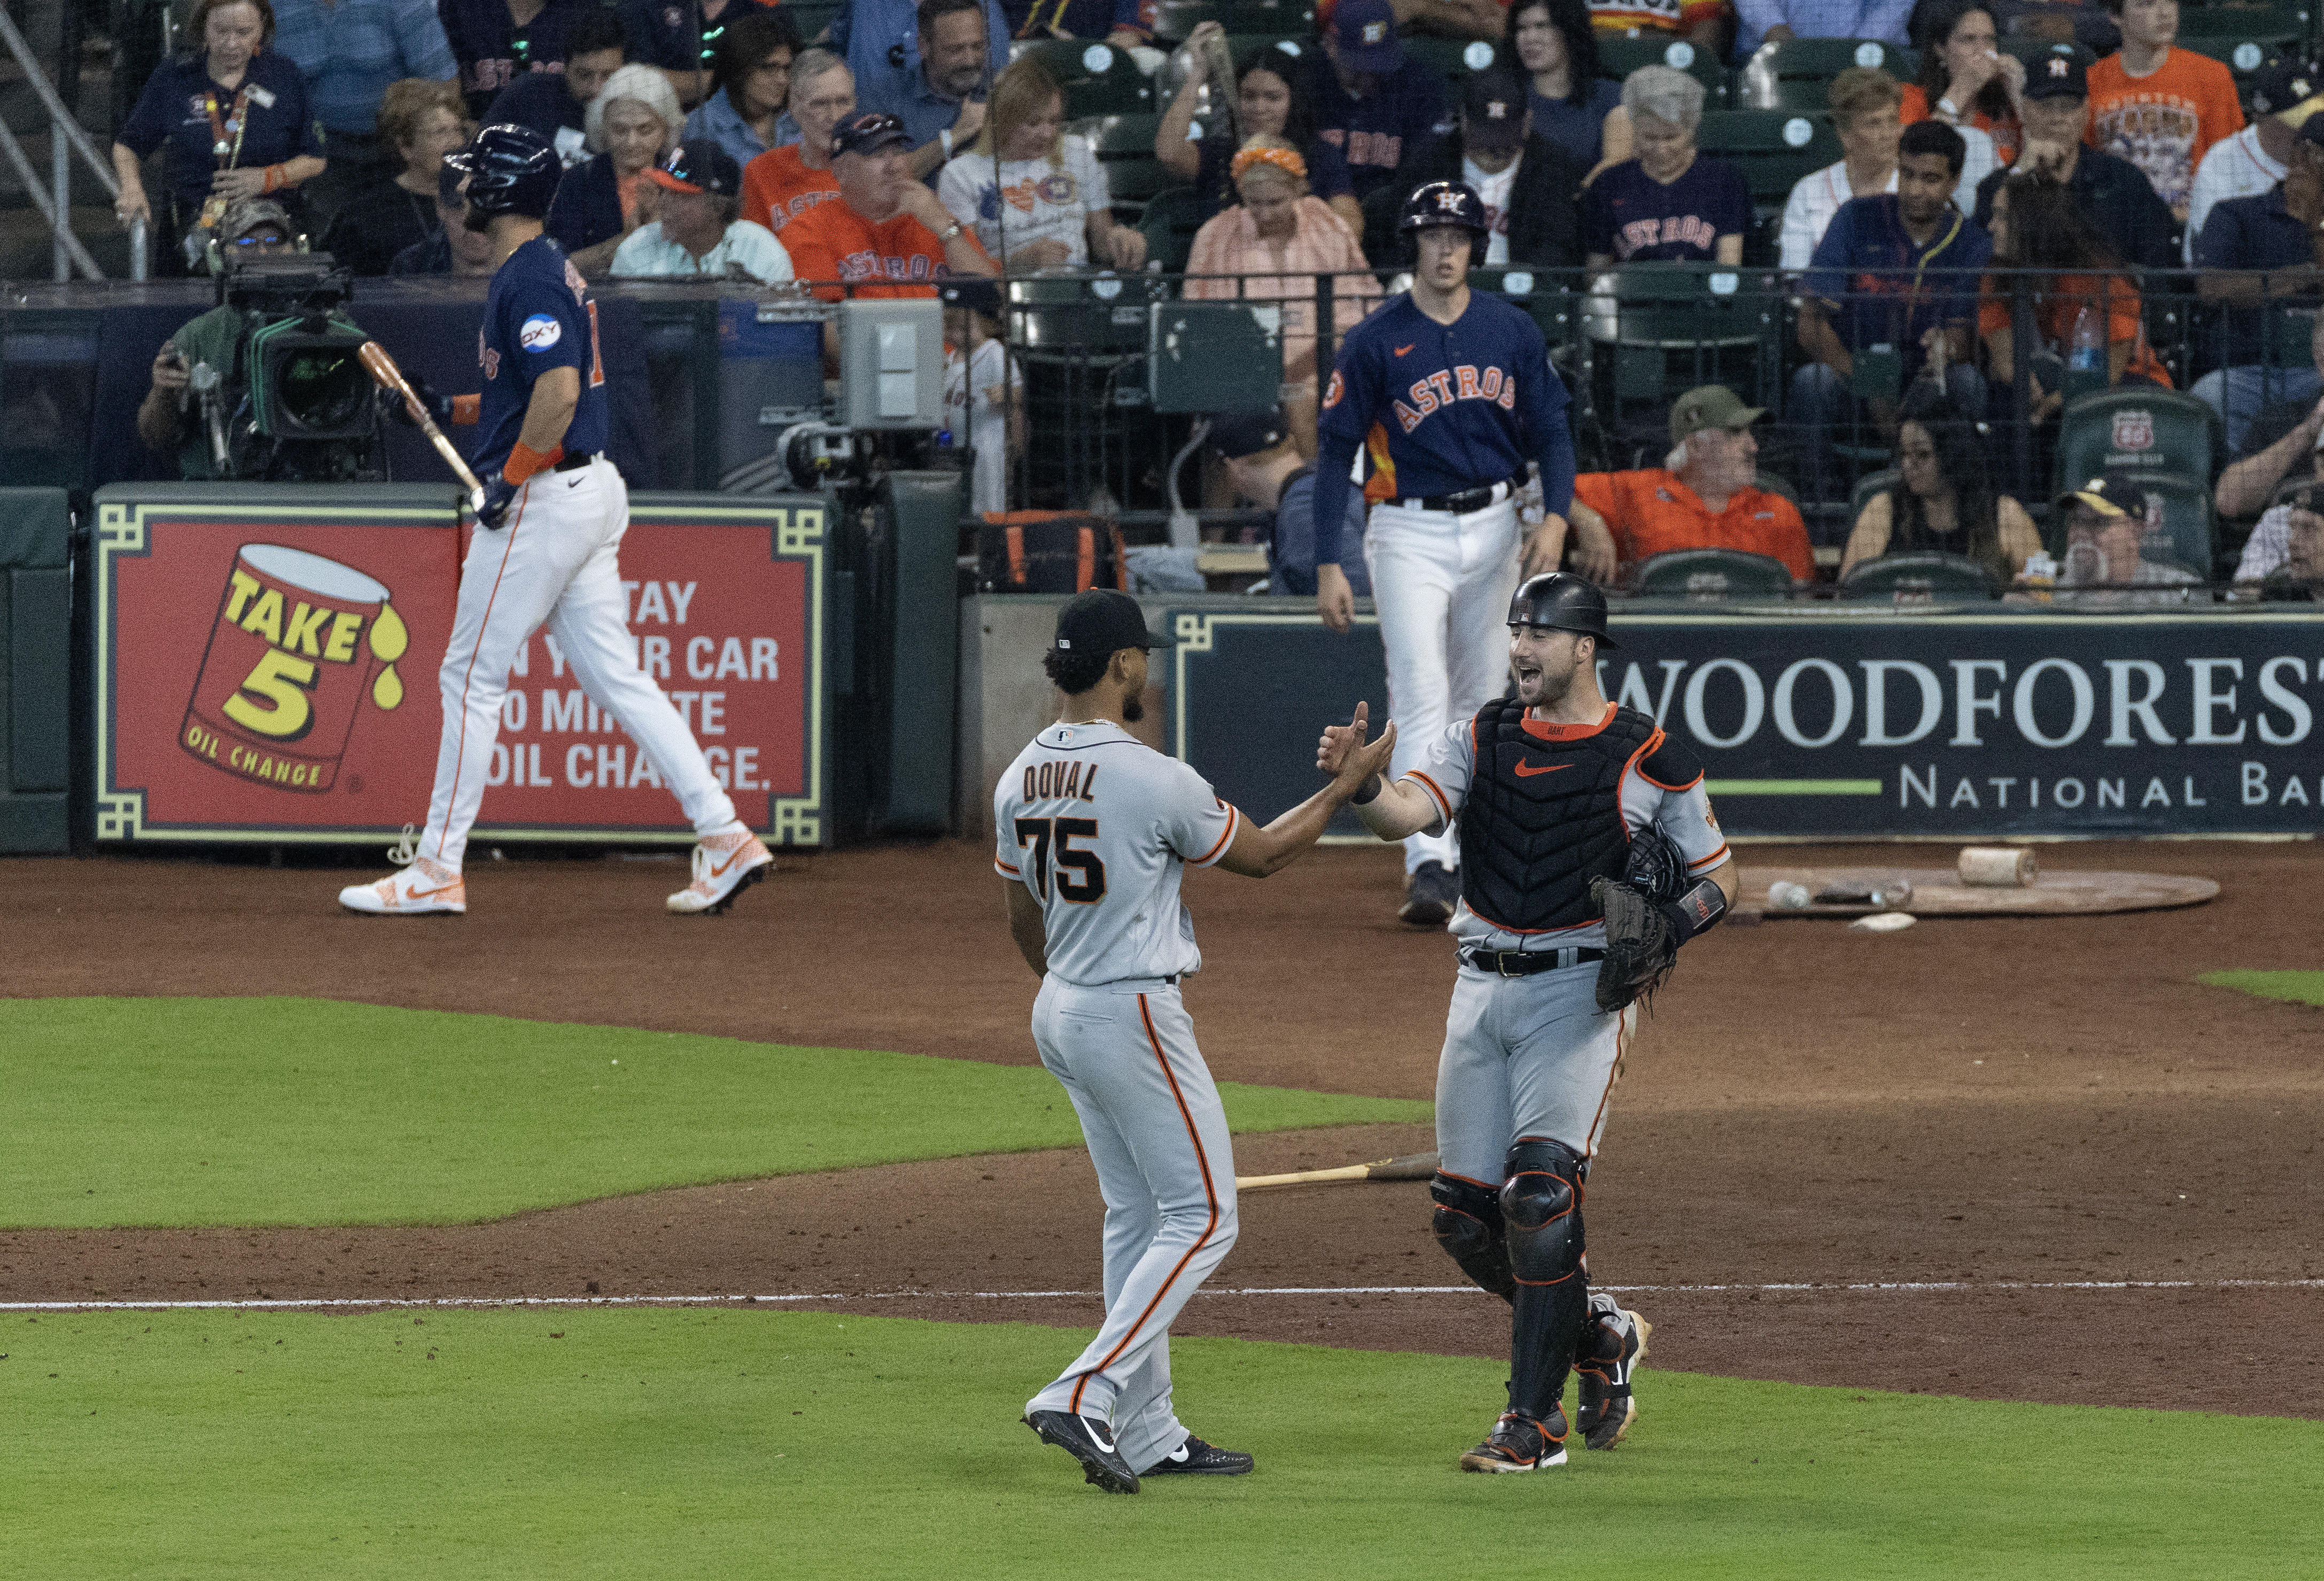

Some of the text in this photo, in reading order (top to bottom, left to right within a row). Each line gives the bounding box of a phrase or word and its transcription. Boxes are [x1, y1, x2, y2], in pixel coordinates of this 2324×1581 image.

[521, 321, 561, 345] OXY
[1393, 364, 1515, 434] ASTROS
[224, 568, 366, 664] TAKE
[620, 580, 697, 625] TAY
[544, 634, 671, 679] YR
[686, 636, 779, 681] CAR
[221, 648, 317, 738] 5
[503, 689, 726, 735] 0 MITE
[1595, 656, 2324, 748] WOODFORES
[1548, 725, 1567, 735] BART
[188, 725, 322, 786] OIL CHANGE
[484, 743, 771, 790] OIL CHAGE.
[1023, 760, 1099, 804] DOVAL
[2241, 761, 2324, 806] BA
[1014, 816, 1107, 904] 75
